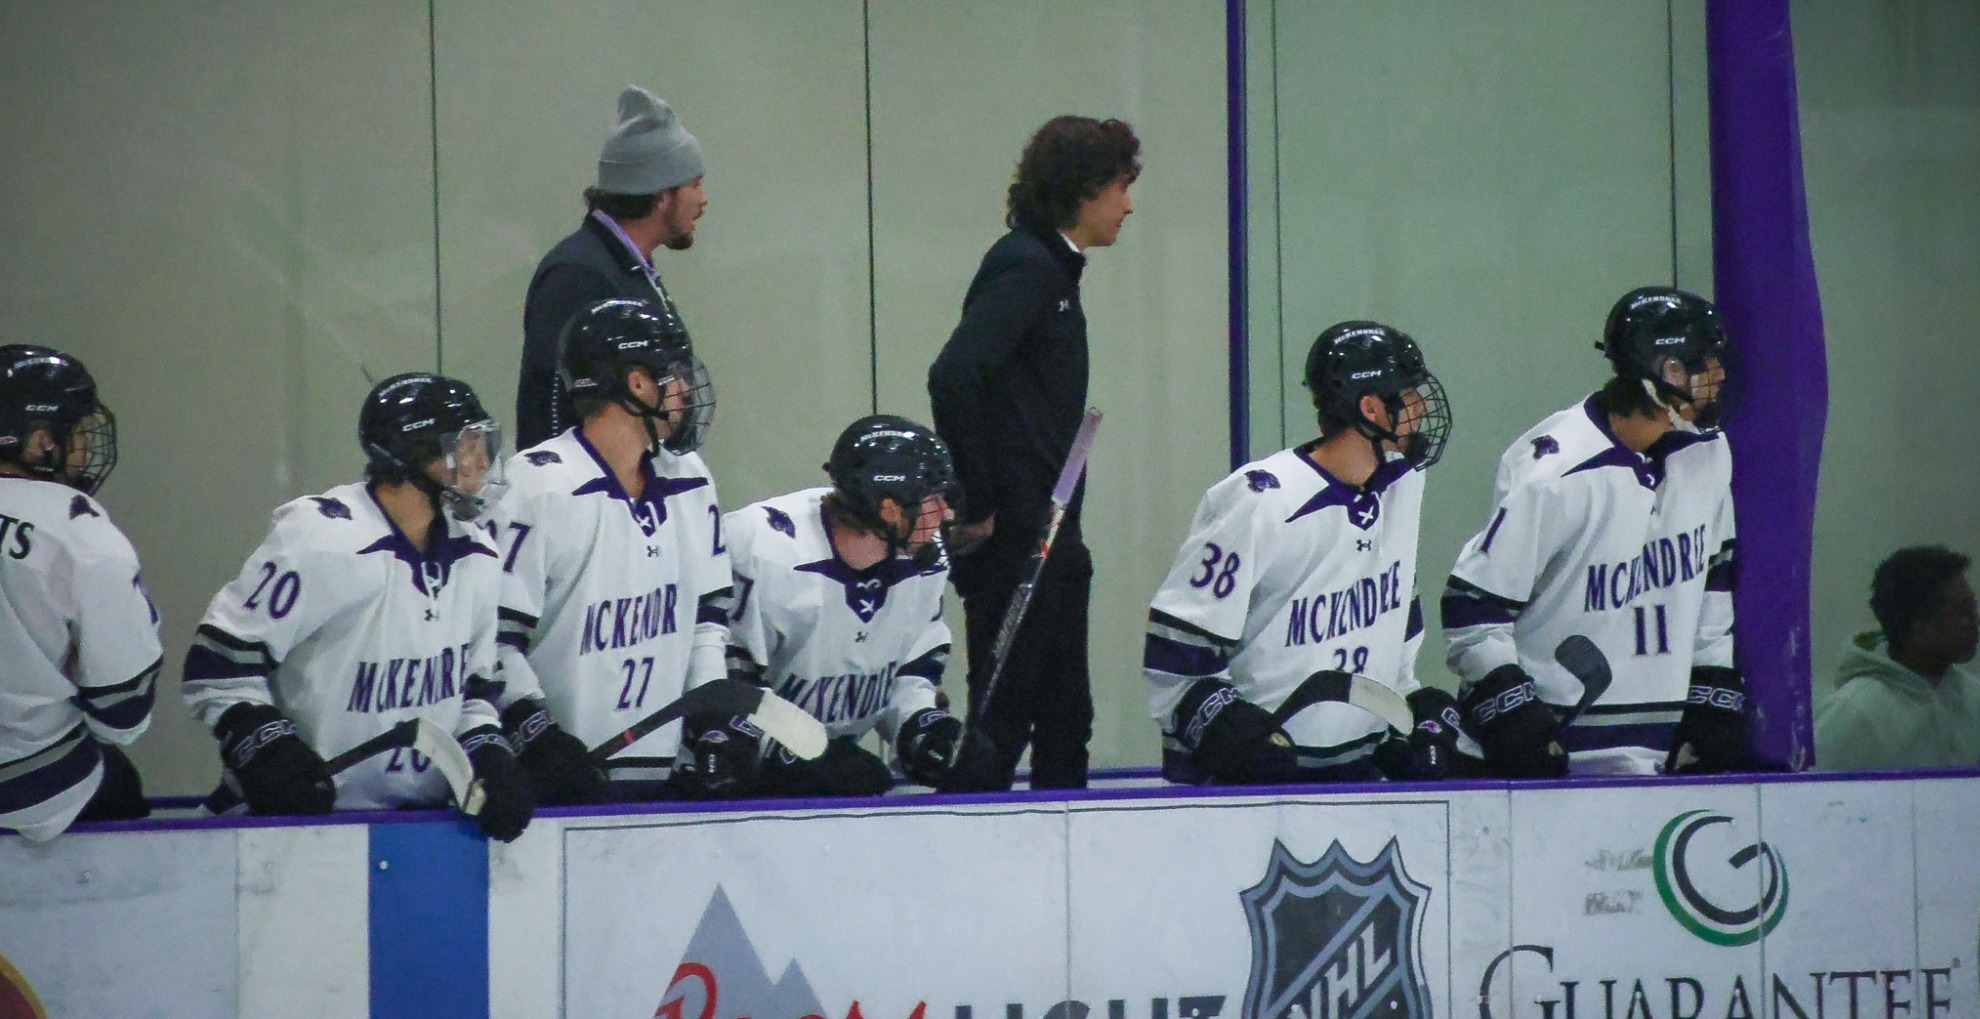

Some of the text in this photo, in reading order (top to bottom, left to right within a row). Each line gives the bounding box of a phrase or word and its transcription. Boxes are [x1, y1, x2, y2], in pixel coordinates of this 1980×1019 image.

[617, 340, 650, 350] CCM
[1655, 336, 1686, 345] CCM
[1351, 370, 1382, 380] CCM
[25, 404, 59, 412] CCM
[402, 418, 435, 432] CCM
[0, 513, 36, 560] TS
[1190, 542, 1240, 600] 38
[243, 561, 301, 620] 20
[1632, 604, 1671, 656] 11
[614, 656, 655, 711] 27
